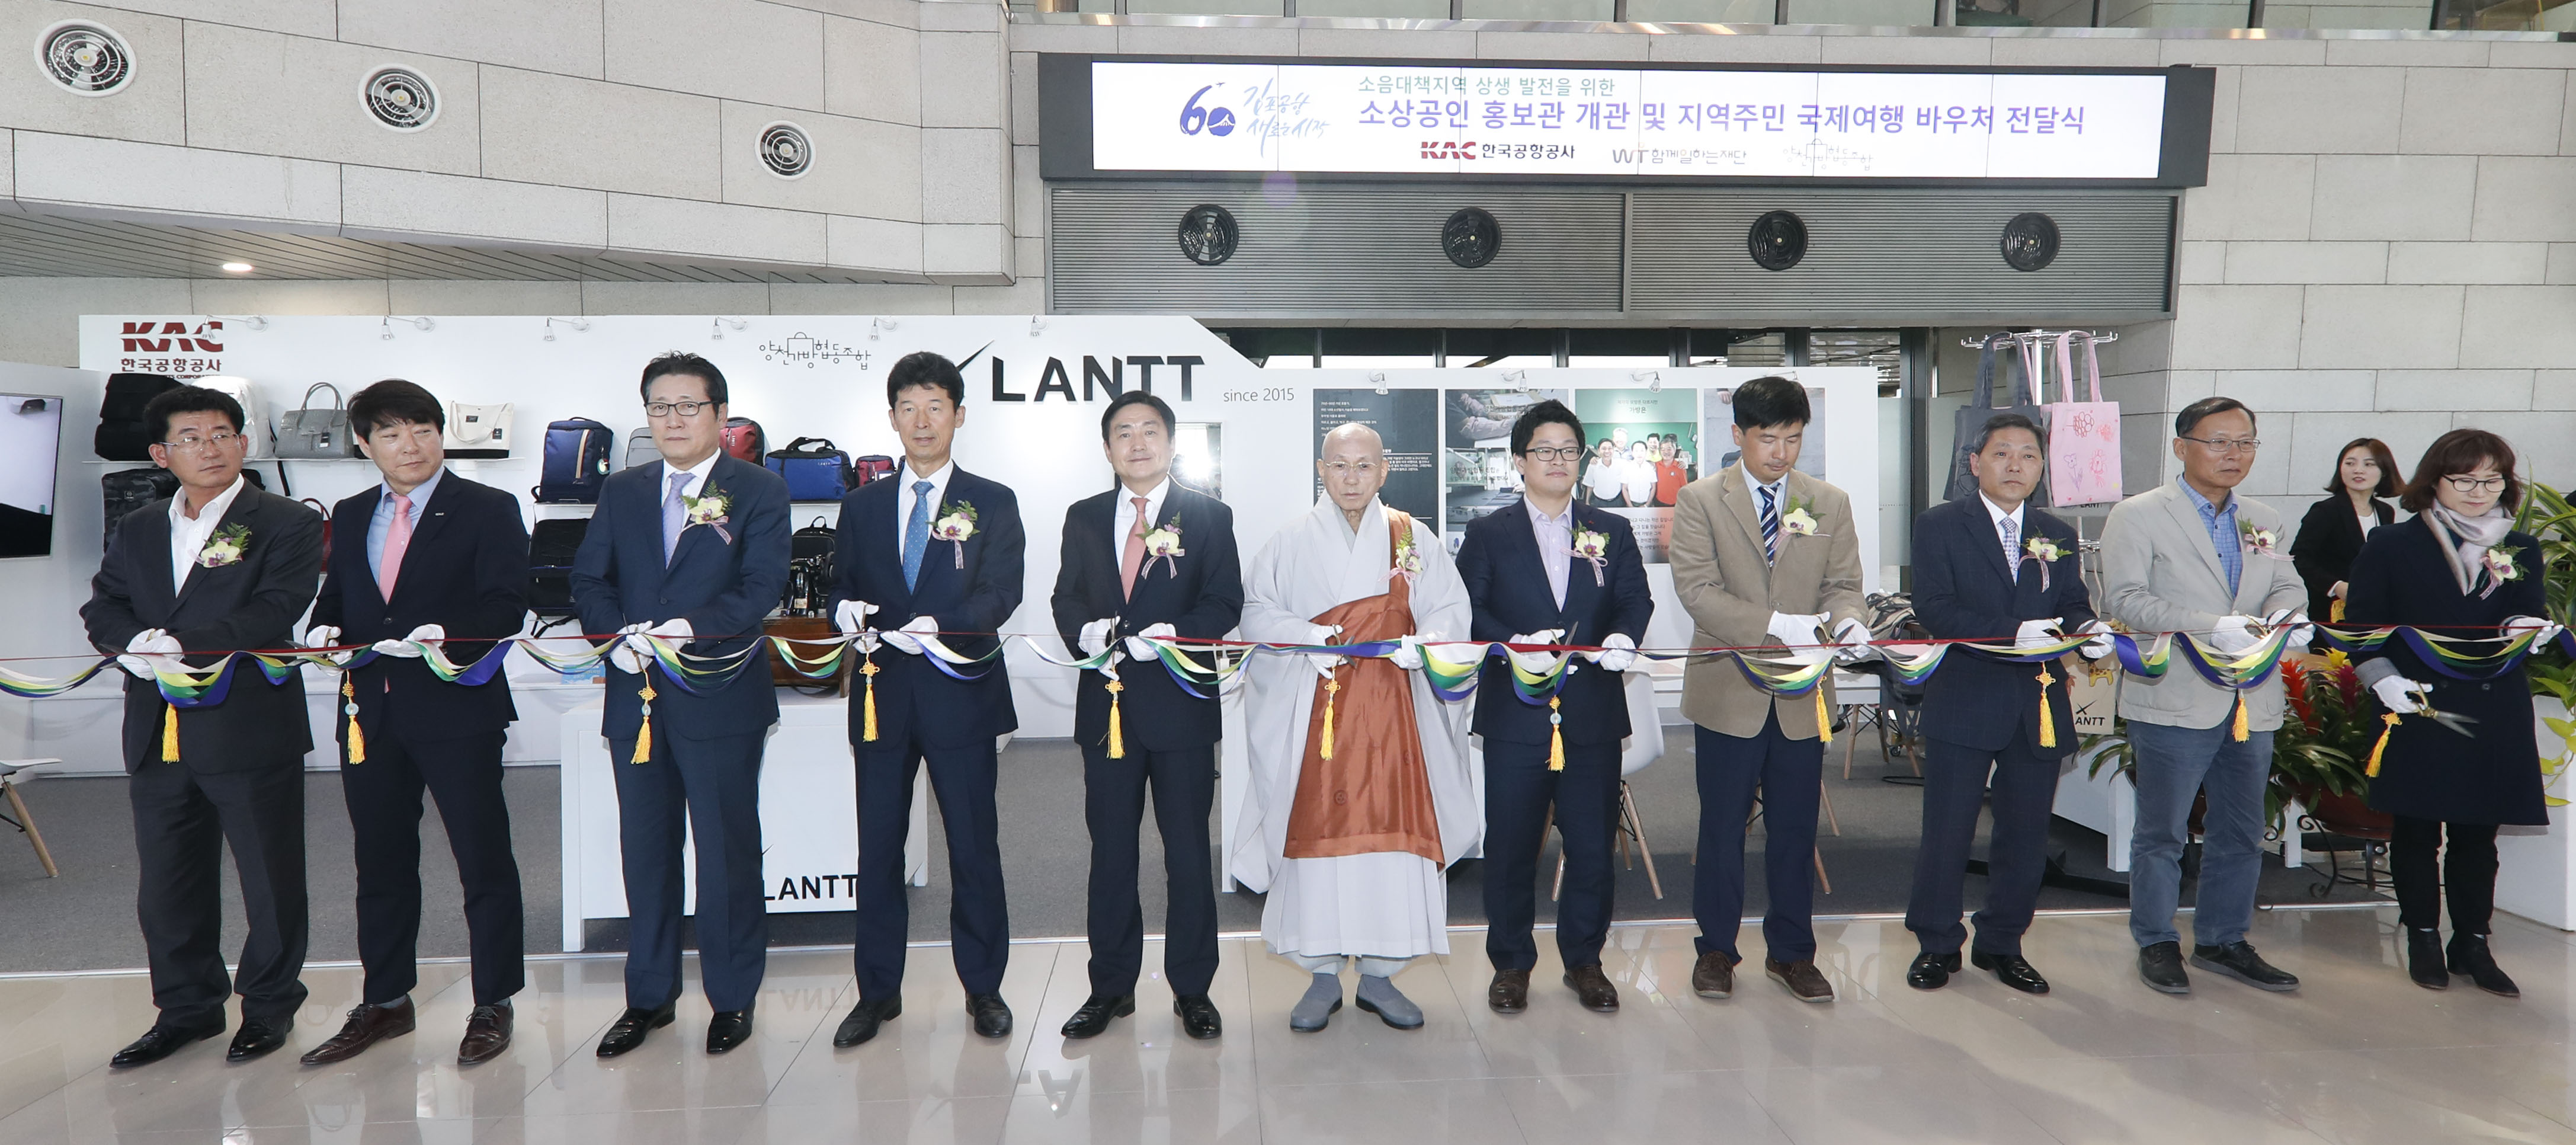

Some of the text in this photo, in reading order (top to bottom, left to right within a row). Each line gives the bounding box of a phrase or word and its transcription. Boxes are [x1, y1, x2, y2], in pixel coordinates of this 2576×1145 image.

[1359, 75, 1616, 97] 소음대책지역 상생 발전을 위한
[1359, 99, 2085, 135] 소상공인 홍보관 개관 및 지역주민 국제여행 바우처 전달식
[1420, 141, 1476, 160] KAC
[1482, 143, 1576, 159] 한국공항공사
[119, 321, 224, 353] KAC
[121, 358, 222, 372] 한국공항공사
[992, 355, 1205, 402] LANTT
[1223, 388, 1295, 402] since 2015
